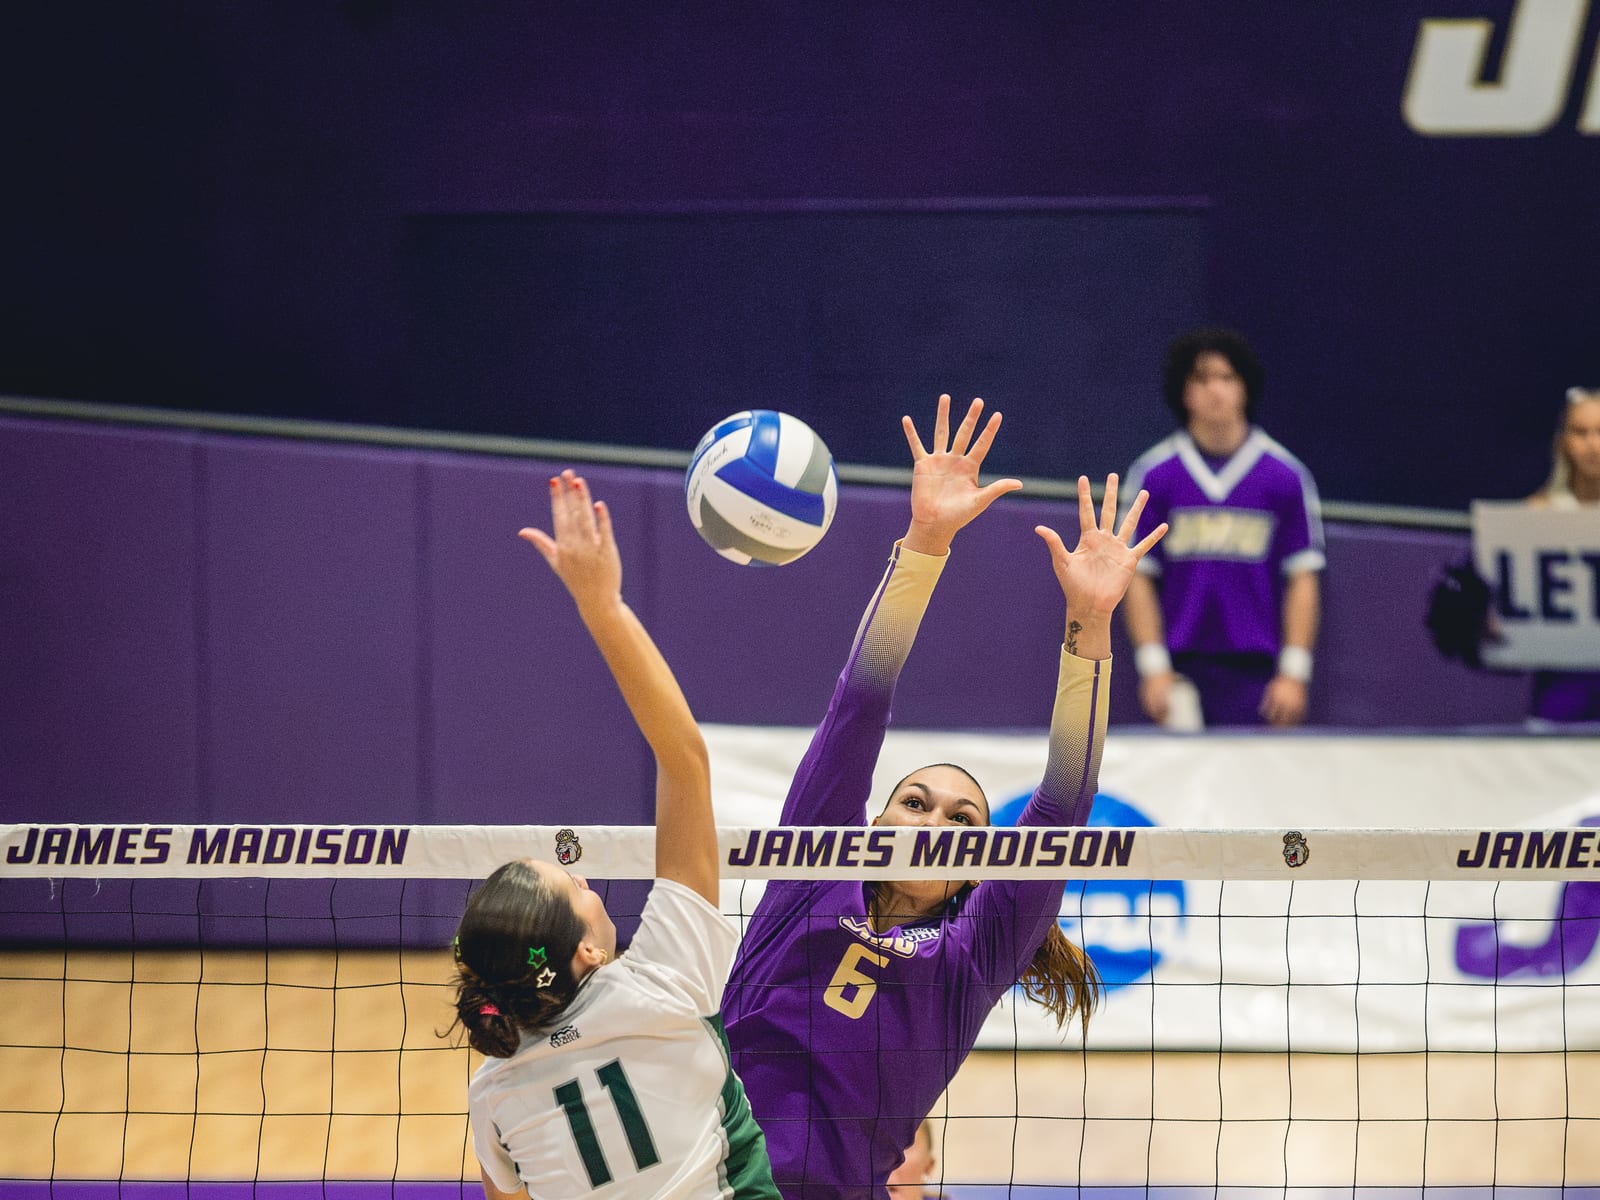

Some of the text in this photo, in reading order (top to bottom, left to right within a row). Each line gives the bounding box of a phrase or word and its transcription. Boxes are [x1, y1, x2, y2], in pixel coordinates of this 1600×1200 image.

[1401, 0, 1600, 137] J
[6, 828, 411, 865] JAMES MADISON
[727, 829, 1137, 868] JAMES MADISON
[823, 942, 890, 1020] 6
[552, 1057, 663, 1191] 11
